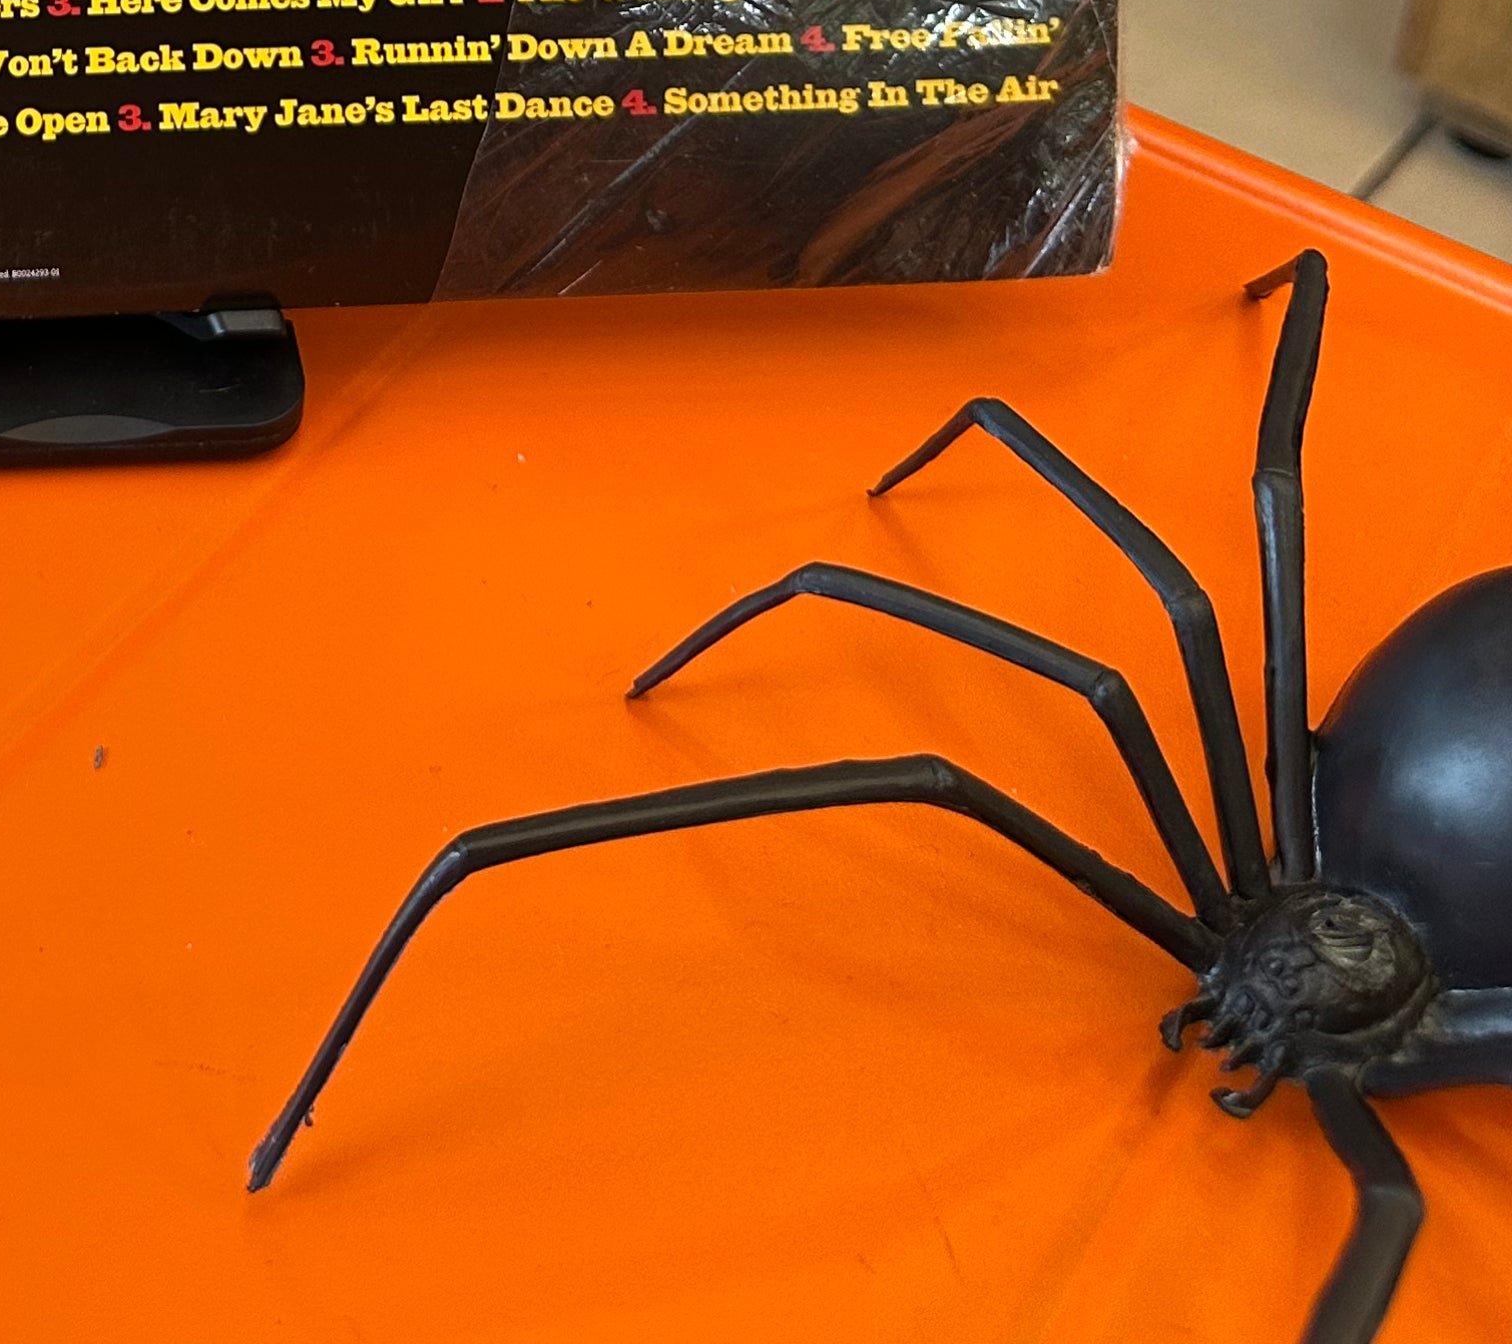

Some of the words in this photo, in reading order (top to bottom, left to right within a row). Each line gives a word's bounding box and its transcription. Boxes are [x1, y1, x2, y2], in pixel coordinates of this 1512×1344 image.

[85, 44, 187, 74] Back
[193, 40, 304, 71] Down
[310, 38, 346, 67] 3.
[351, 34, 502, 66] Runnin'
[507, 31, 619, 62] Down
[625, 30, 657, 60] A
[663, 27, 794, 57] Dream
[800, 24, 836, 53] 4.
[842, 21, 931, 52] Free
[15, 106, 112, 143] Open
[118, 103, 153, 132] 3.
[159, 100, 269, 135] Mary
[275, 95, 397, 129] Jane's
[401, 93, 490, 124] Last
[494, 91, 615, 120] Dance
[621, 89, 657, 117] 4.
[663, 83, 862, 117] Something
[867, 80, 910, 109] In
[916, 77, 990, 108] The
[996, 74, 1061, 104] Air
